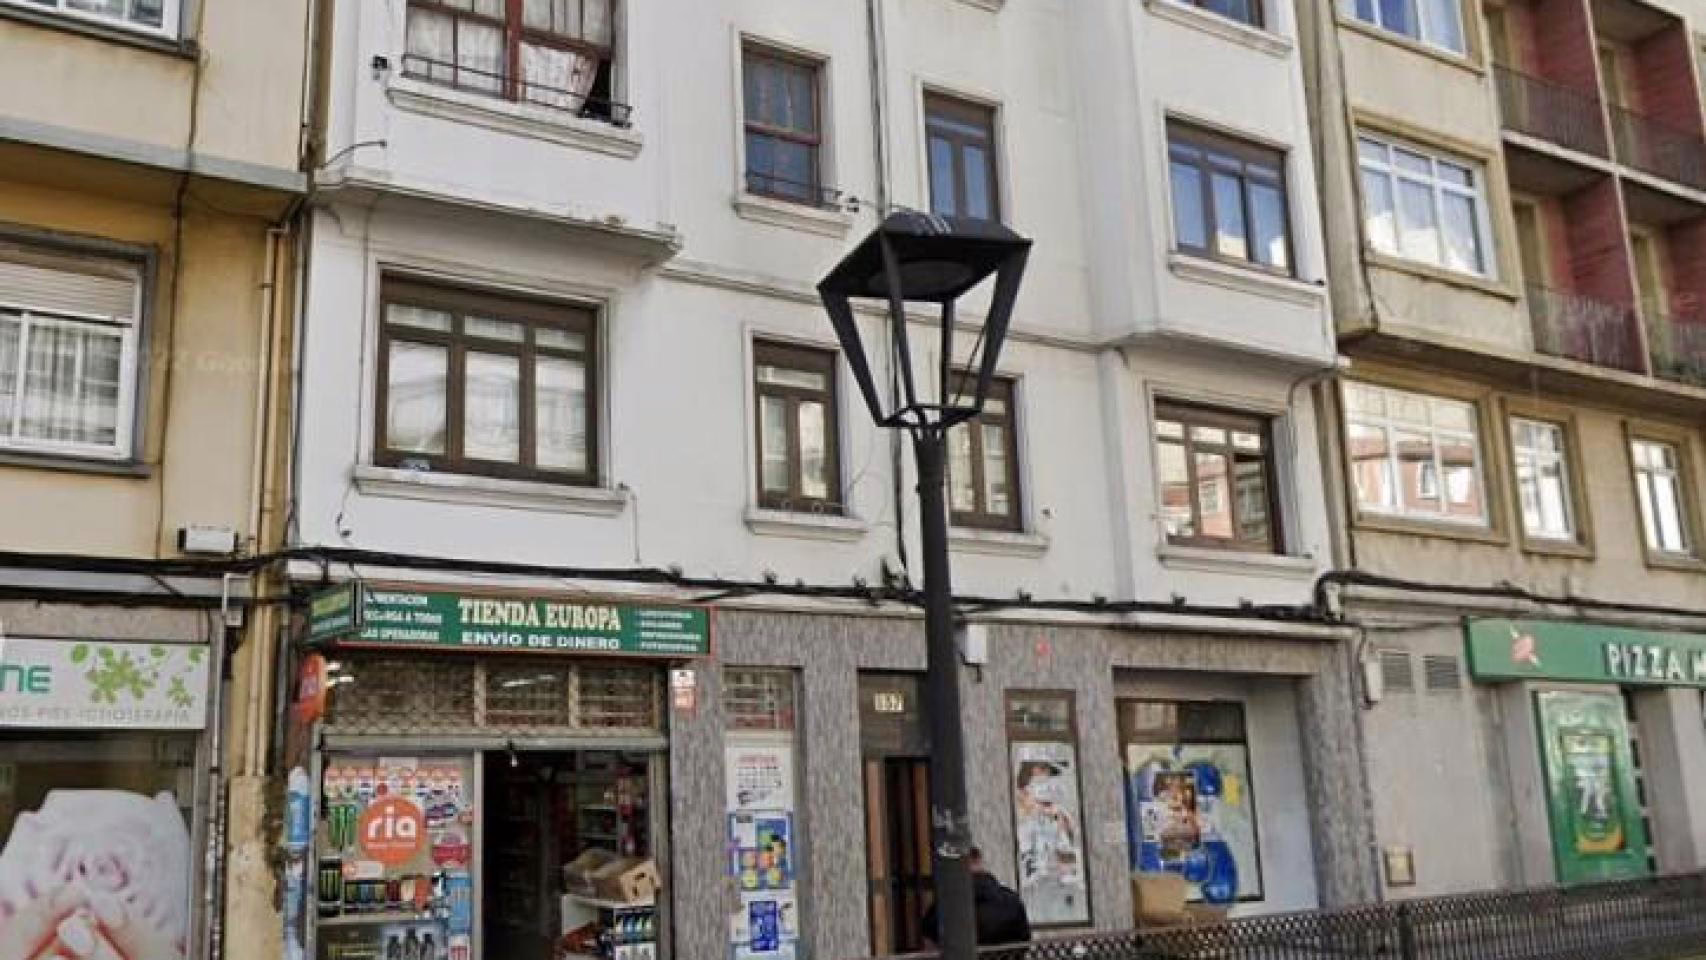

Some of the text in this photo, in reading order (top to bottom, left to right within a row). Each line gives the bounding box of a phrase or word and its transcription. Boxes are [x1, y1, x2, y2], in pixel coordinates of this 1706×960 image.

[457, 598, 622, 632] TIENDA EUROPA
[527, 634, 553, 648] DE
[556, 636, 620, 651] DINERO
[1606, 641, 1683, 680] PIZZA
[367, 806, 417, 840] ria
